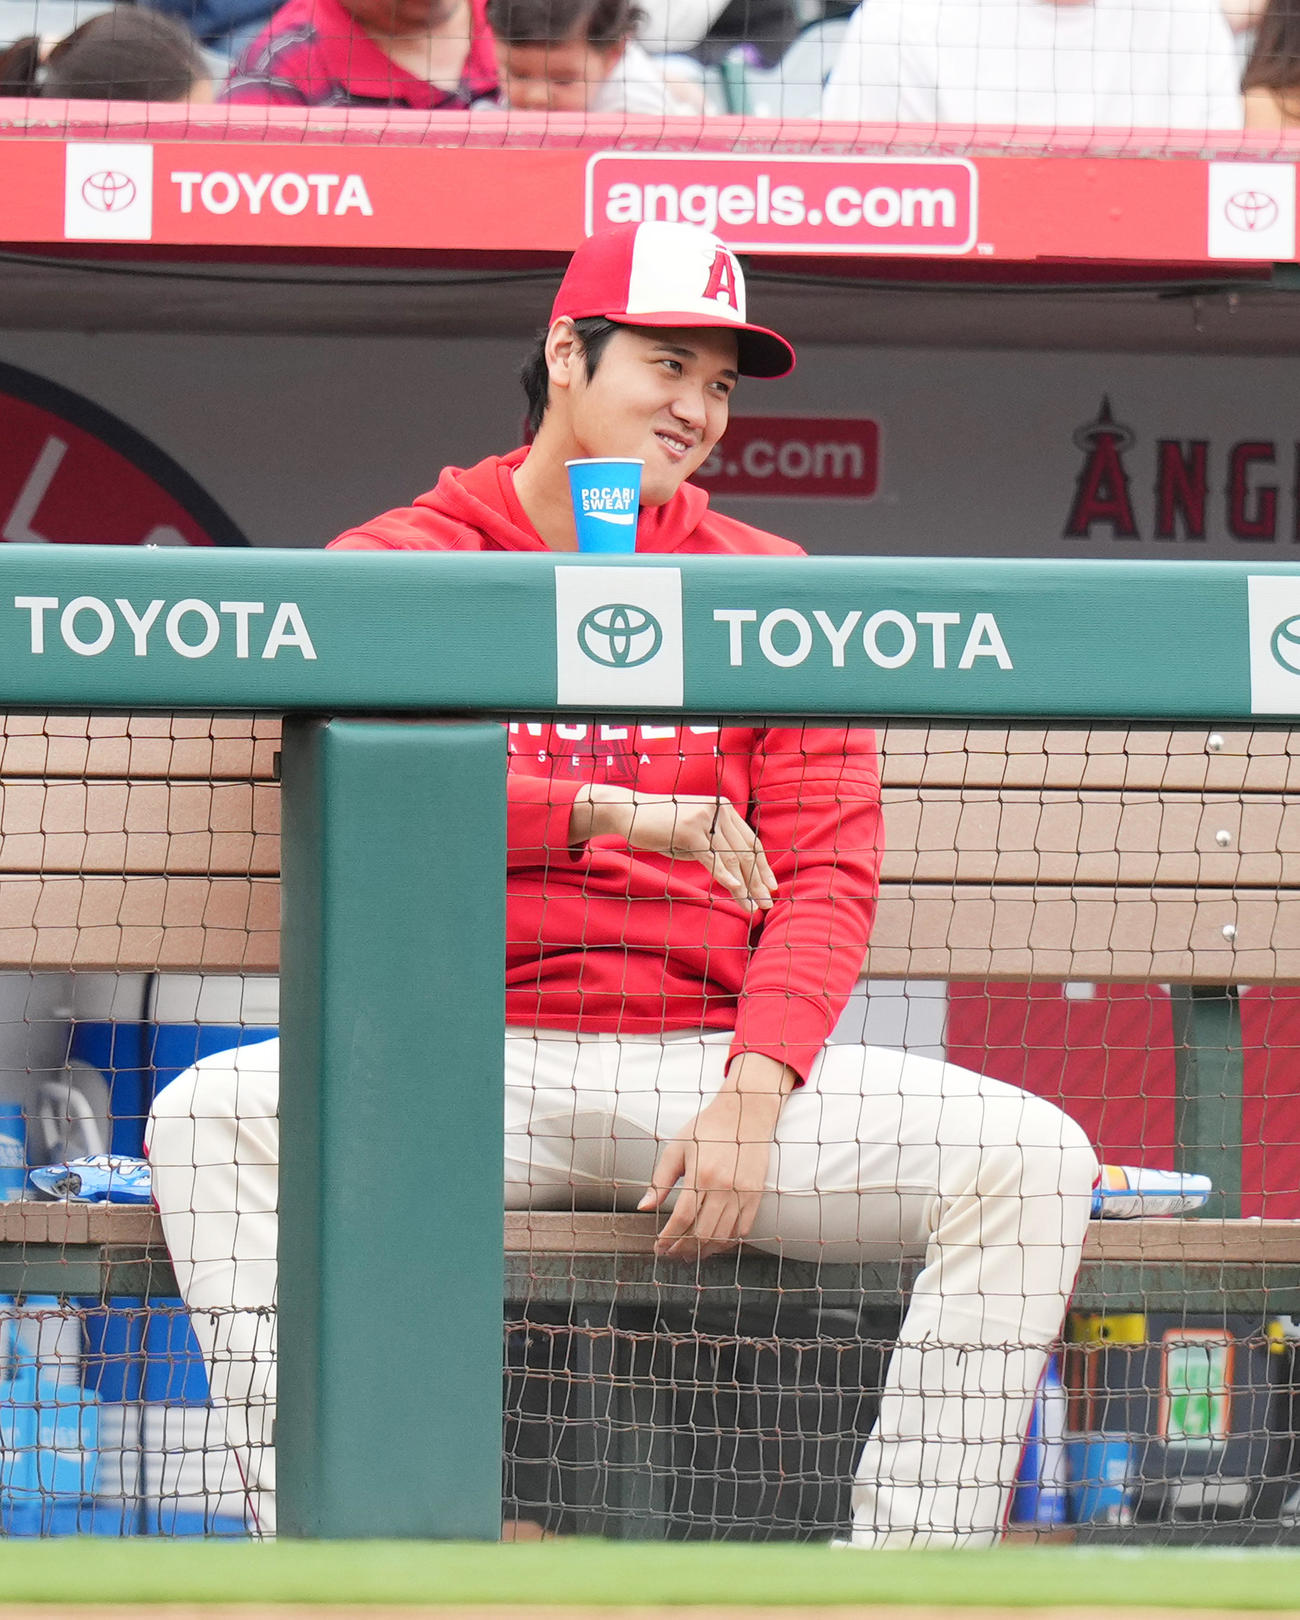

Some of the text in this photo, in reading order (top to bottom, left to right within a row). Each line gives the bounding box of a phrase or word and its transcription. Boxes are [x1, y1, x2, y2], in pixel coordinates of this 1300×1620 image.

[171, 171, 374, 217] TOYOTA
[605, 174, 956, 235] angels.com
[581, 487, 635, 501] POCARI
[582, 499, 632, 511] SWEAT
[1062, 410, 1300, 543] ANG
[14, 596, 318, 661] TOYOTA
[713, 608, 1014, 671] TOYOTA
